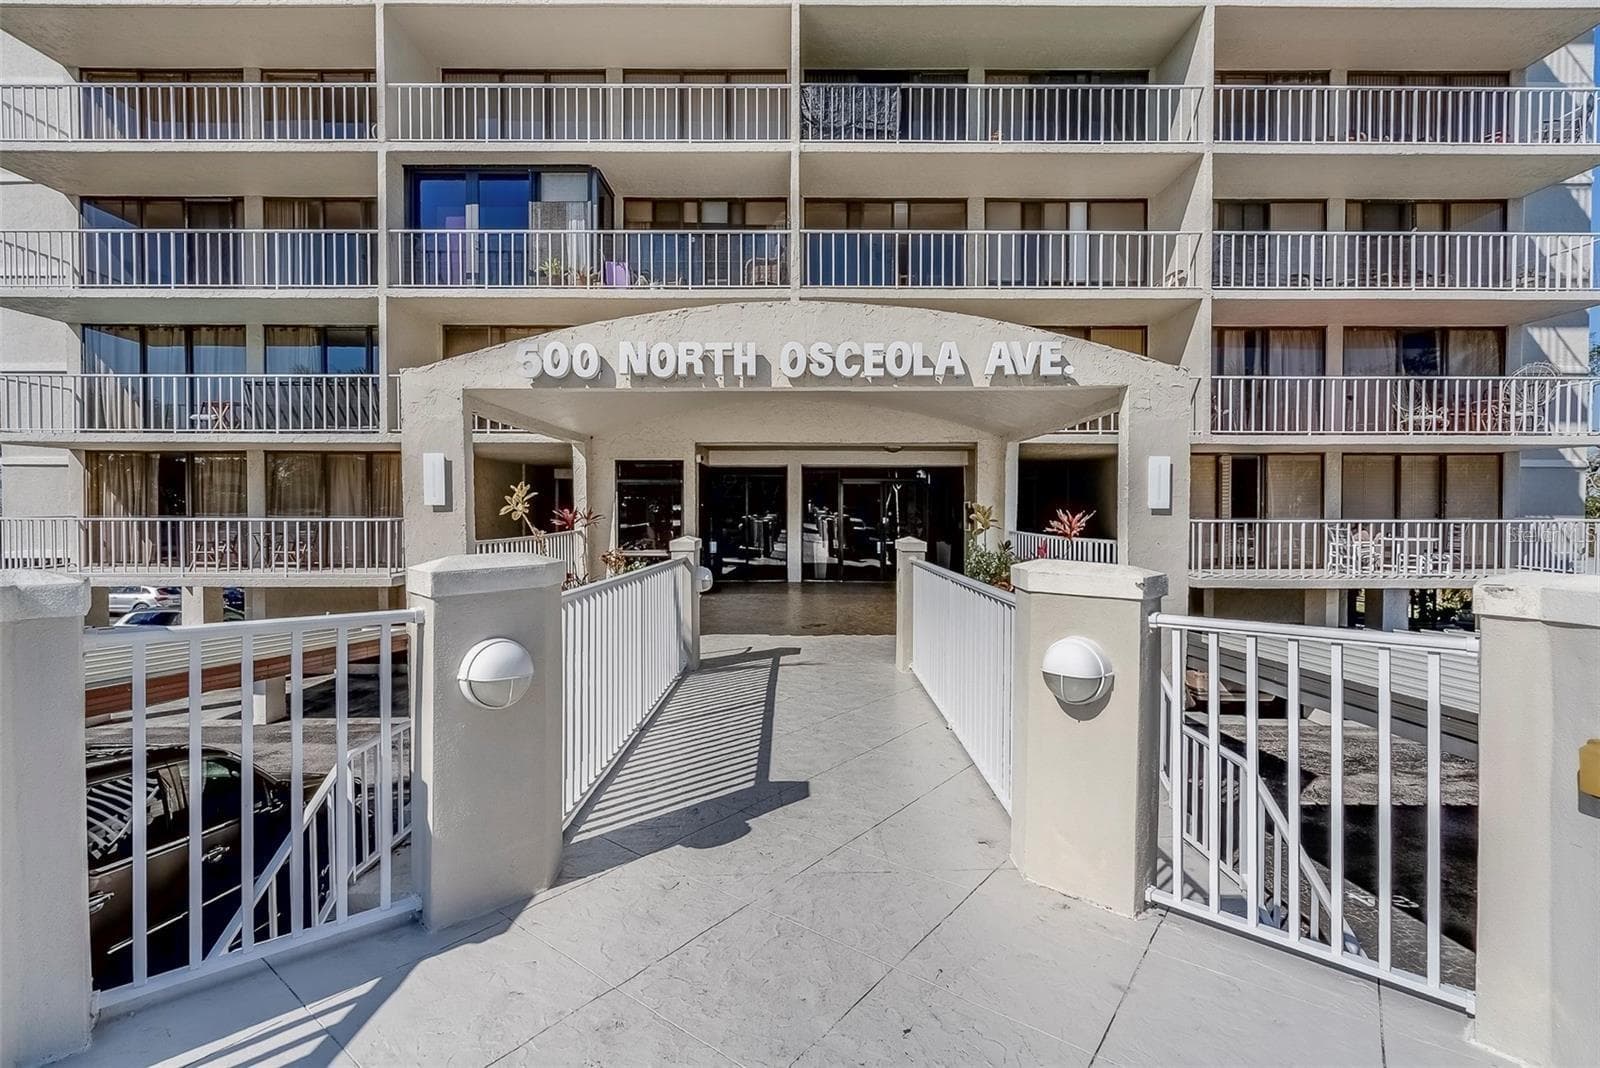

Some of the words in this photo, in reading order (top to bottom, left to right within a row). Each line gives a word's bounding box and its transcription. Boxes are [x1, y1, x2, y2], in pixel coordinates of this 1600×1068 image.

[518, 342, 601, 378] 500
[619, 341, 757, 379] NORTH
[780, 340, 966, 377] OSCEOLA
[984, 341, 1075, 376] AVE.
